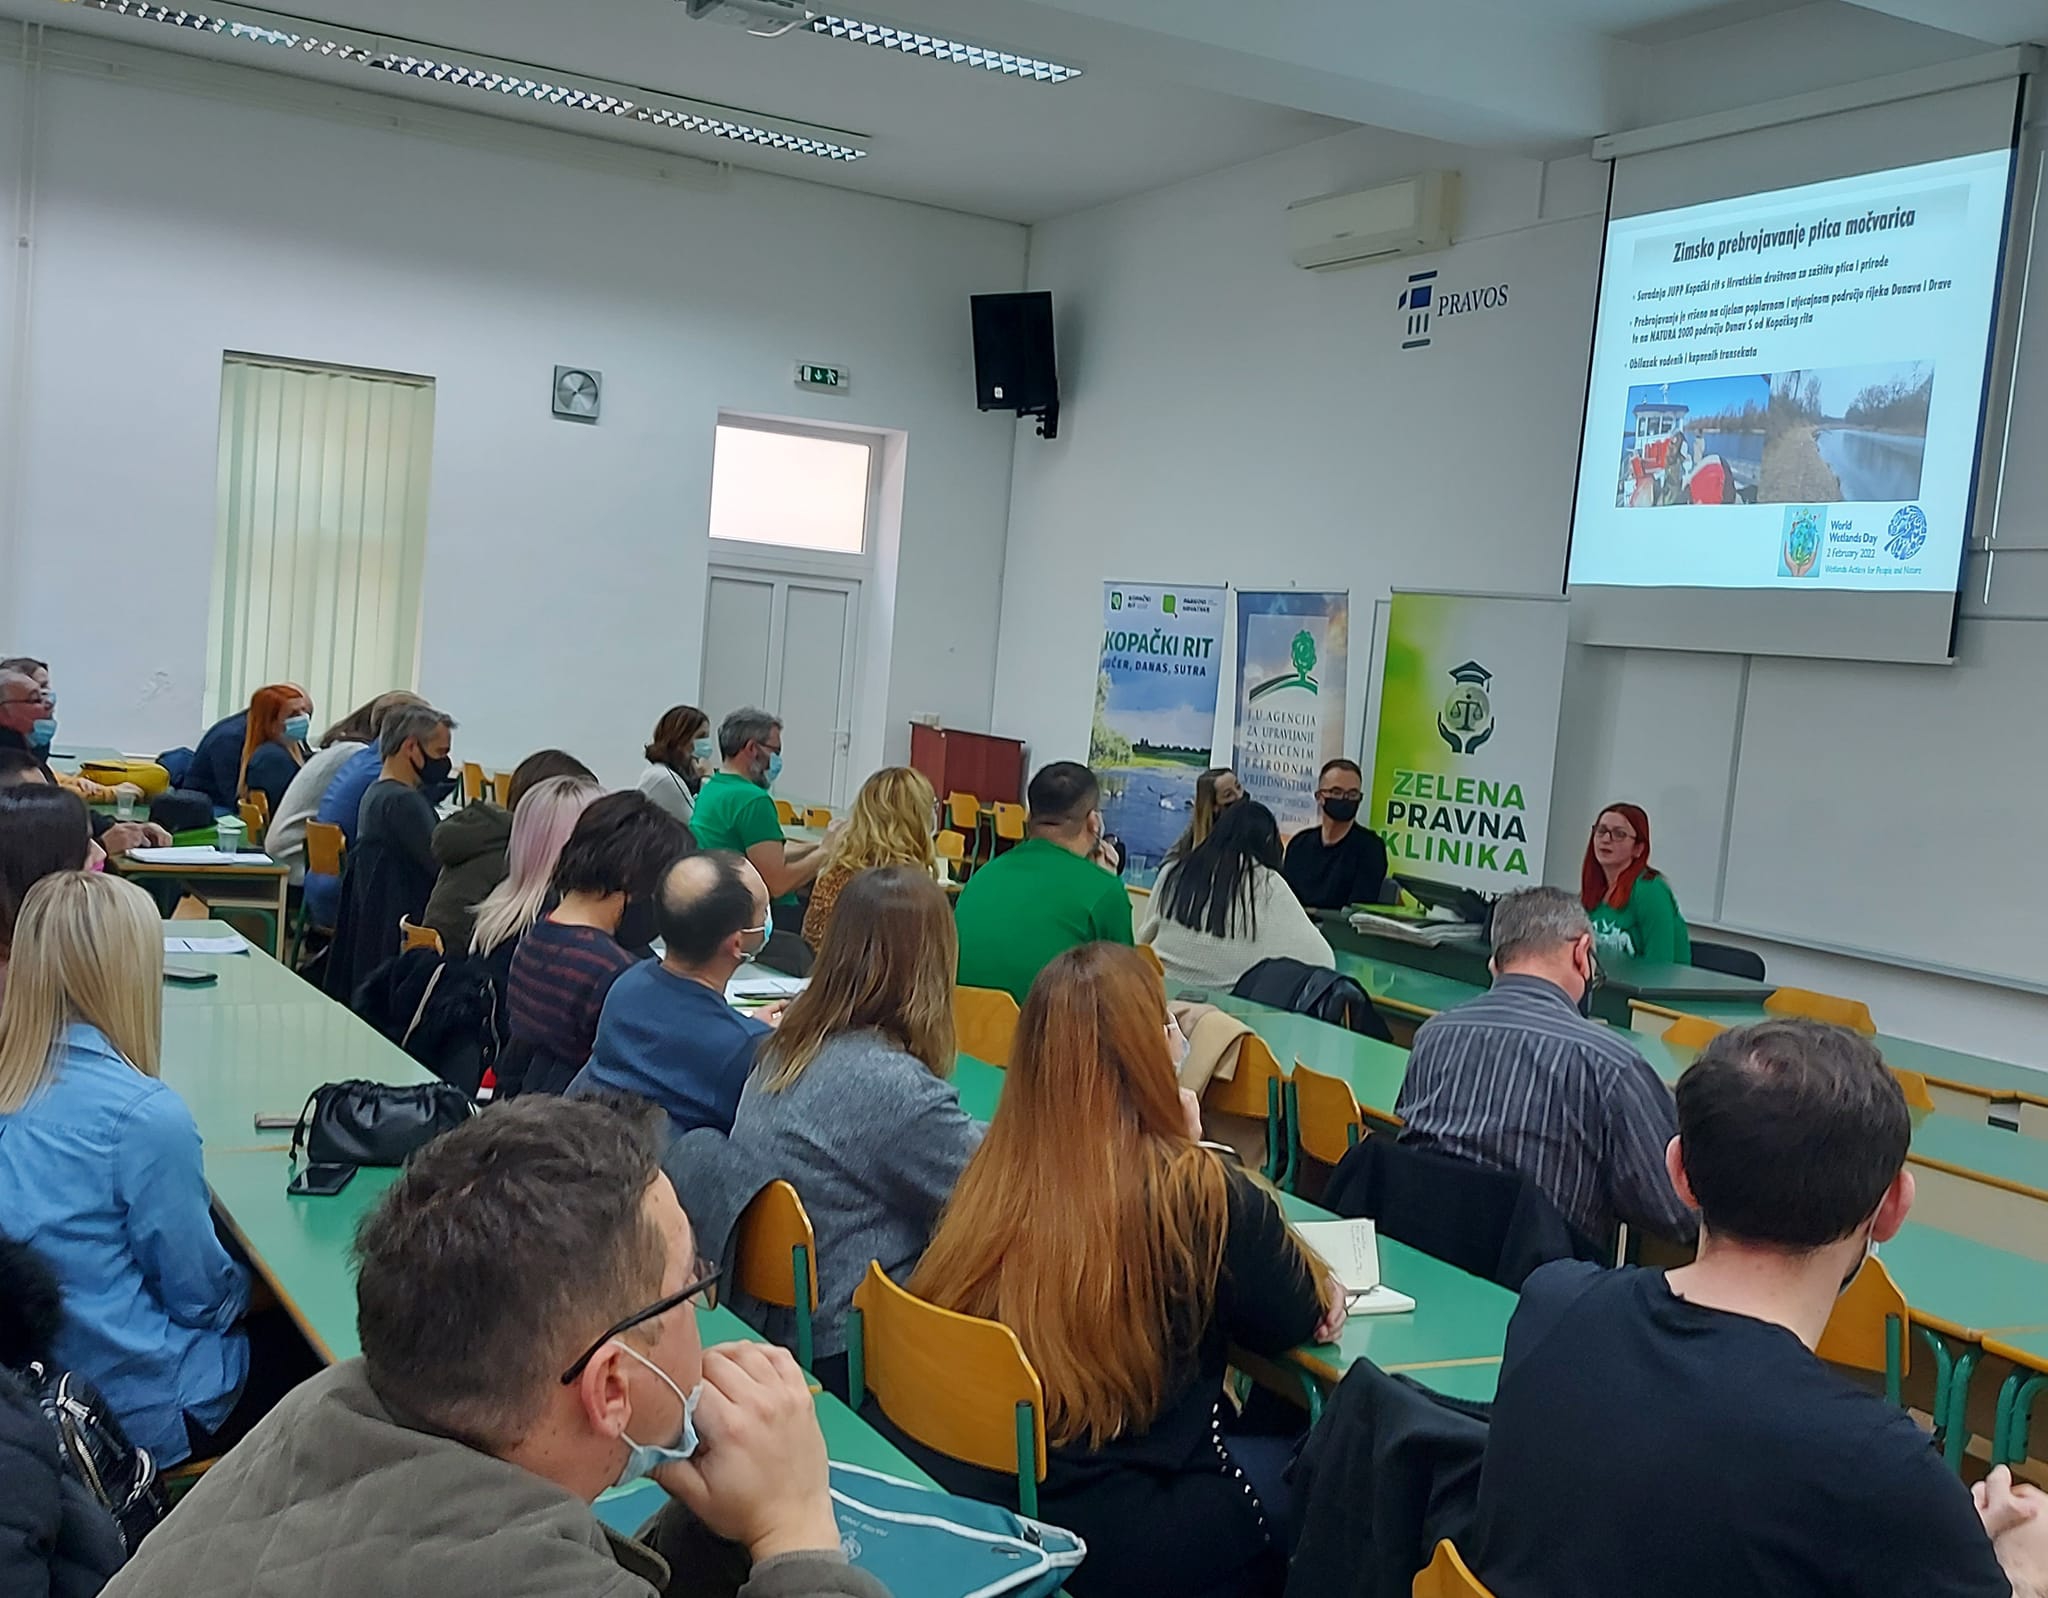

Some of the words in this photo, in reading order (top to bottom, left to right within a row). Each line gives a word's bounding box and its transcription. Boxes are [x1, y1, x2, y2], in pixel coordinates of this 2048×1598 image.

[1672, 237, 1715, 263] Zimsko
[1717, 222, 1806, 261] prebrojavanje
[1808, 217, 1842, 247] ptica
[1845, 206, 1916, 236] močvarica
[1667, 284, 1684, 298] JUPP
[1685, 280, 1710, 297] Kopački
[1711, 280, 1720, 291] rit
[1726, 273, 1763, 289] Hrvatskim
[1763, 270, 1797, 284] društvom
[1798, 269, 1807, 279] za
[1808, 263, 1834, 277] zaštitu
[1834, 261, 1854, 277] ptica
[1860, 254, 1889, 273] prirode
[1437, 284, 1509, 317] PRAVOS
[1634, 311, 1679, 328] Prebrojavanje
[1679, 310, 1686, 324] je
[1687, 308, 1708, 321] vršeno
[1709, 308, 1719, 318] na
[1719, 303, 1744, 319] cijelom
[1744, 299, 1785, 316] poplavnom
[1791, 293, 1830, 310] utjecajnom
[1831, 288, 1864, 307] području
[1865, 284, 1889, 301] rijeka
[1891, 283, 1922, 296] Dunava
[1928, 279, 1952, 291] Drave
[1631, 333, 1639, 344] te
[1640, 334, 1649, 343] na
[1649, 328, 1677, 342] NATURA
[1677, 325, 1694, 339] 2000
[1694, 323, 1724, 340] području
[1725, 321, 1747, 333] Dunav
[1747, 318, 1753, 330] S
[1754, 317, 1764, 329] od
[1765, 314, 1799, 331] Kopačkog
[1799, 312, 1814, 325] rita
[1629, 356, 1658, 369] Obilazak
[1659, 353, 1684, 367] vodenih
[1719, 345, 1758, 360] transekata
[1829, 532, 1862, 543] Wetlands
[1862, 532, 1878, 546] Day
[1830, 520, 1853, 531] World
[1832, 547, 1858, 560] February
[1859, 548, 1876, 559] 2022
[1104, 627, 1179, 656] KOPAČKI
[1183, 636, 1214, 659] RIT
[1135, 660, 1172, 675] DANAS,
[1173, 663, 1206, 677] SUTRA
[1247, 725, 1258, 737] ZA
[1244, 756, 1313, 777] PRIRODNIM
[1243, 773, 1312, 793] VRIJEDNOSTIMA
[1393, 771, 1526, 811] ZELENA
[1386, 800, 1527, 843] PRAVNA
[1381, 830, 1529, 876] KLINIKA
